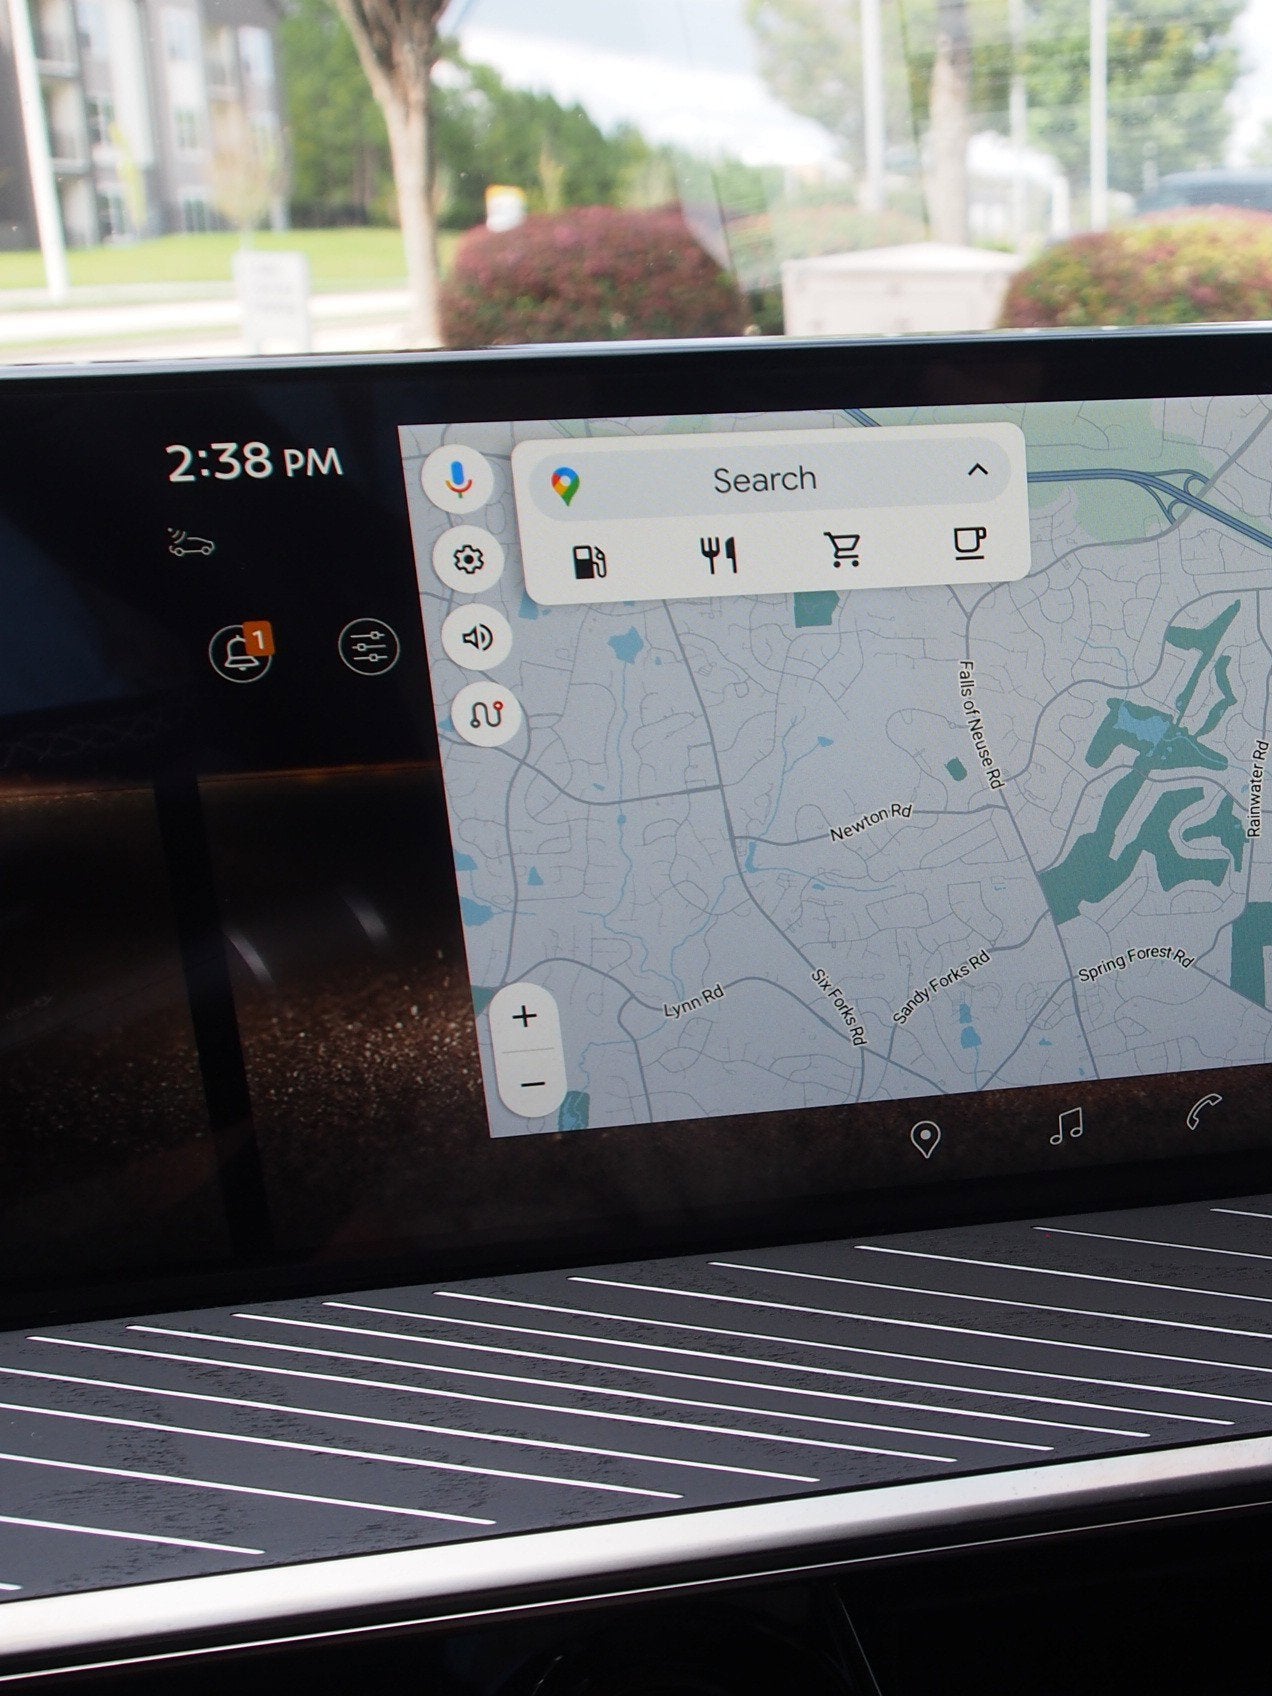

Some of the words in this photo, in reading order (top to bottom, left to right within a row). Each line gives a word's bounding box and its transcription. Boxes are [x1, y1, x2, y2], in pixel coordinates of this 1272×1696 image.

[166, 441, 272, 482] 2:38
[284, 447, 344, 477] PM
[713, 465, 818, 494] Search
[253, 630, 267, 649] 1
[960, 661, 974, 697] Falls
[963, 700, 980, 717] of
[968, 718, 993, 767] Neuse
[1253, 740, 1269, 761] Rd
[986, 768, 1005, 790] Rd
[1247, 763, 1263, 838] Rainwater
[830, 811, 889, 842] Newton
[891, 803, 913, 819] Rd
[1079, 955, 1126, 982] Spring
[1127, 947, 1172, 963] Forest
[1173, 949, 1195, 969] Rd
[663, 992, 698, 1018] Lynn
[701, 984, 724, 1003] Rd
[893, 987, 930, 1025] Sandy
[929, 965, 970, 993] Forks
[969, 950, 991, 970] Rd
[812, 969, 831, 991] Six
[828, 988, 857, 1026] Forks
[850, 1026, 867, 1046] Rd
